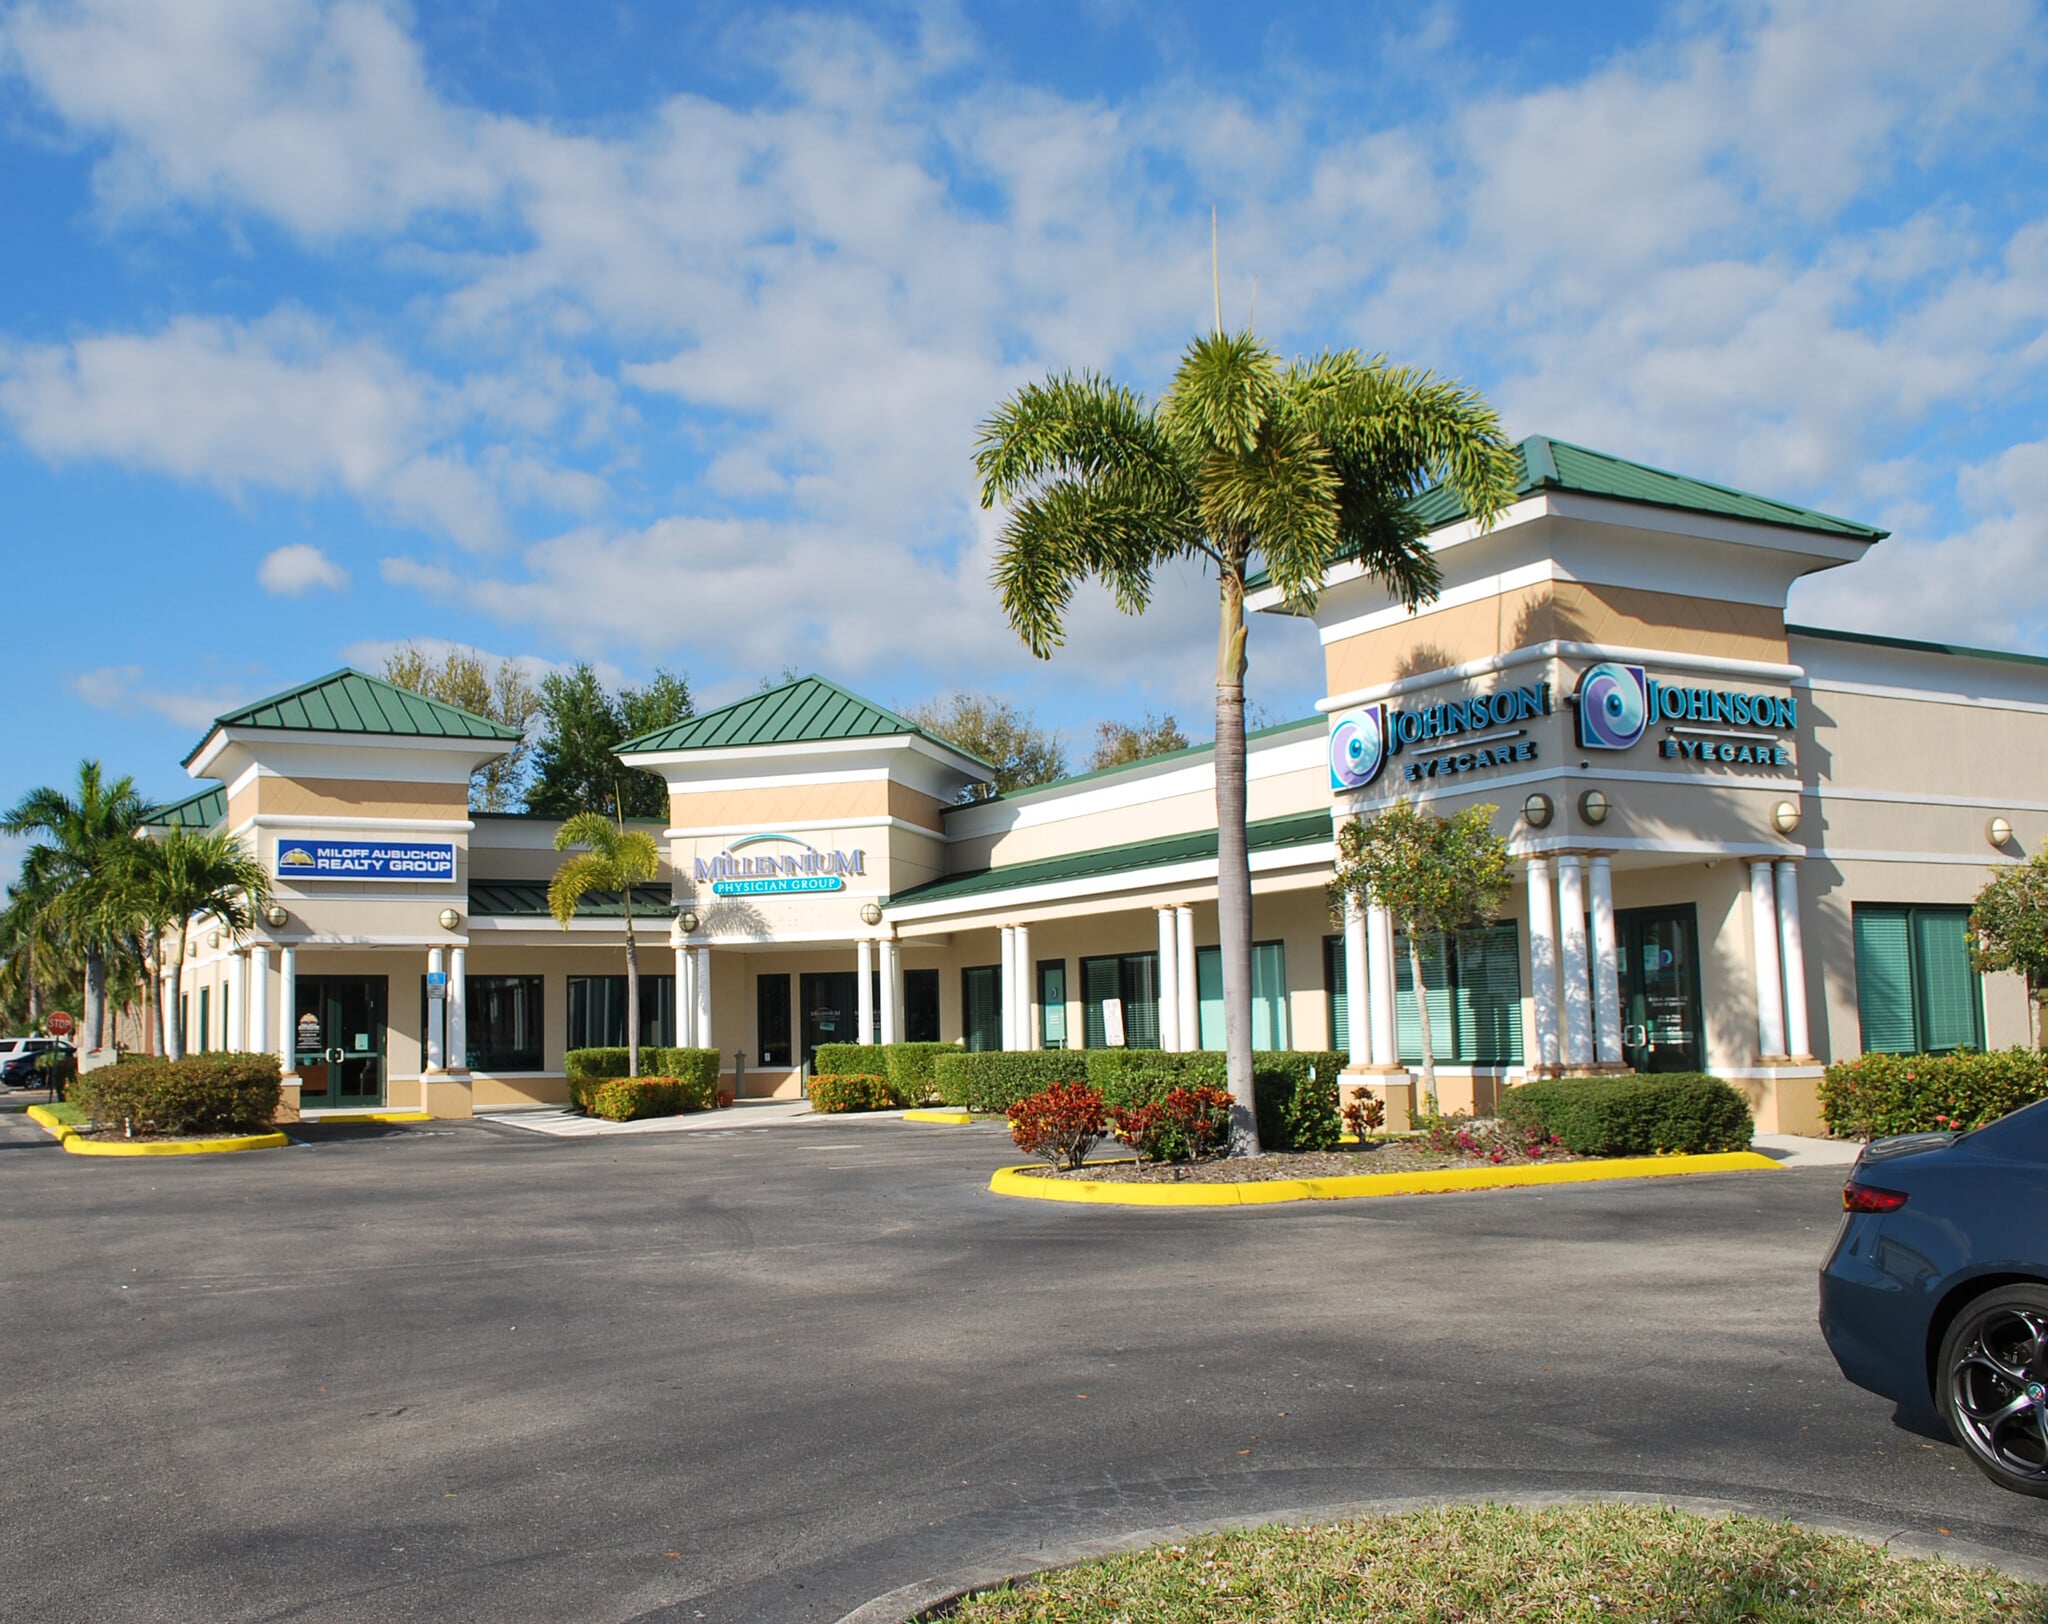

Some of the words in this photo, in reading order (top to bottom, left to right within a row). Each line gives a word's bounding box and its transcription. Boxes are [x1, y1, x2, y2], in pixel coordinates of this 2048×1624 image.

[1647, 679, 1798, 729] JOHNSON
[1386, 682, 1545, 756] JOHNSON
[1403, 741, 1532, 781] EYECARE
[1665, 737, 1788, 765] EYECARE
[317, 848, 370, 858] MILOFF
[371, 849, 451, 860] AUBUCHON
[317, 859, 383, 870] REALTY
[389, 860, 451, 872] GROUP
[694, 848, 864, 881] MILLENNIUM
[717, 880, 788, 893] PHYSICIAN
[791, 878, 836, 890] GROUP
[48, 1018, 72, 1029] STOP
